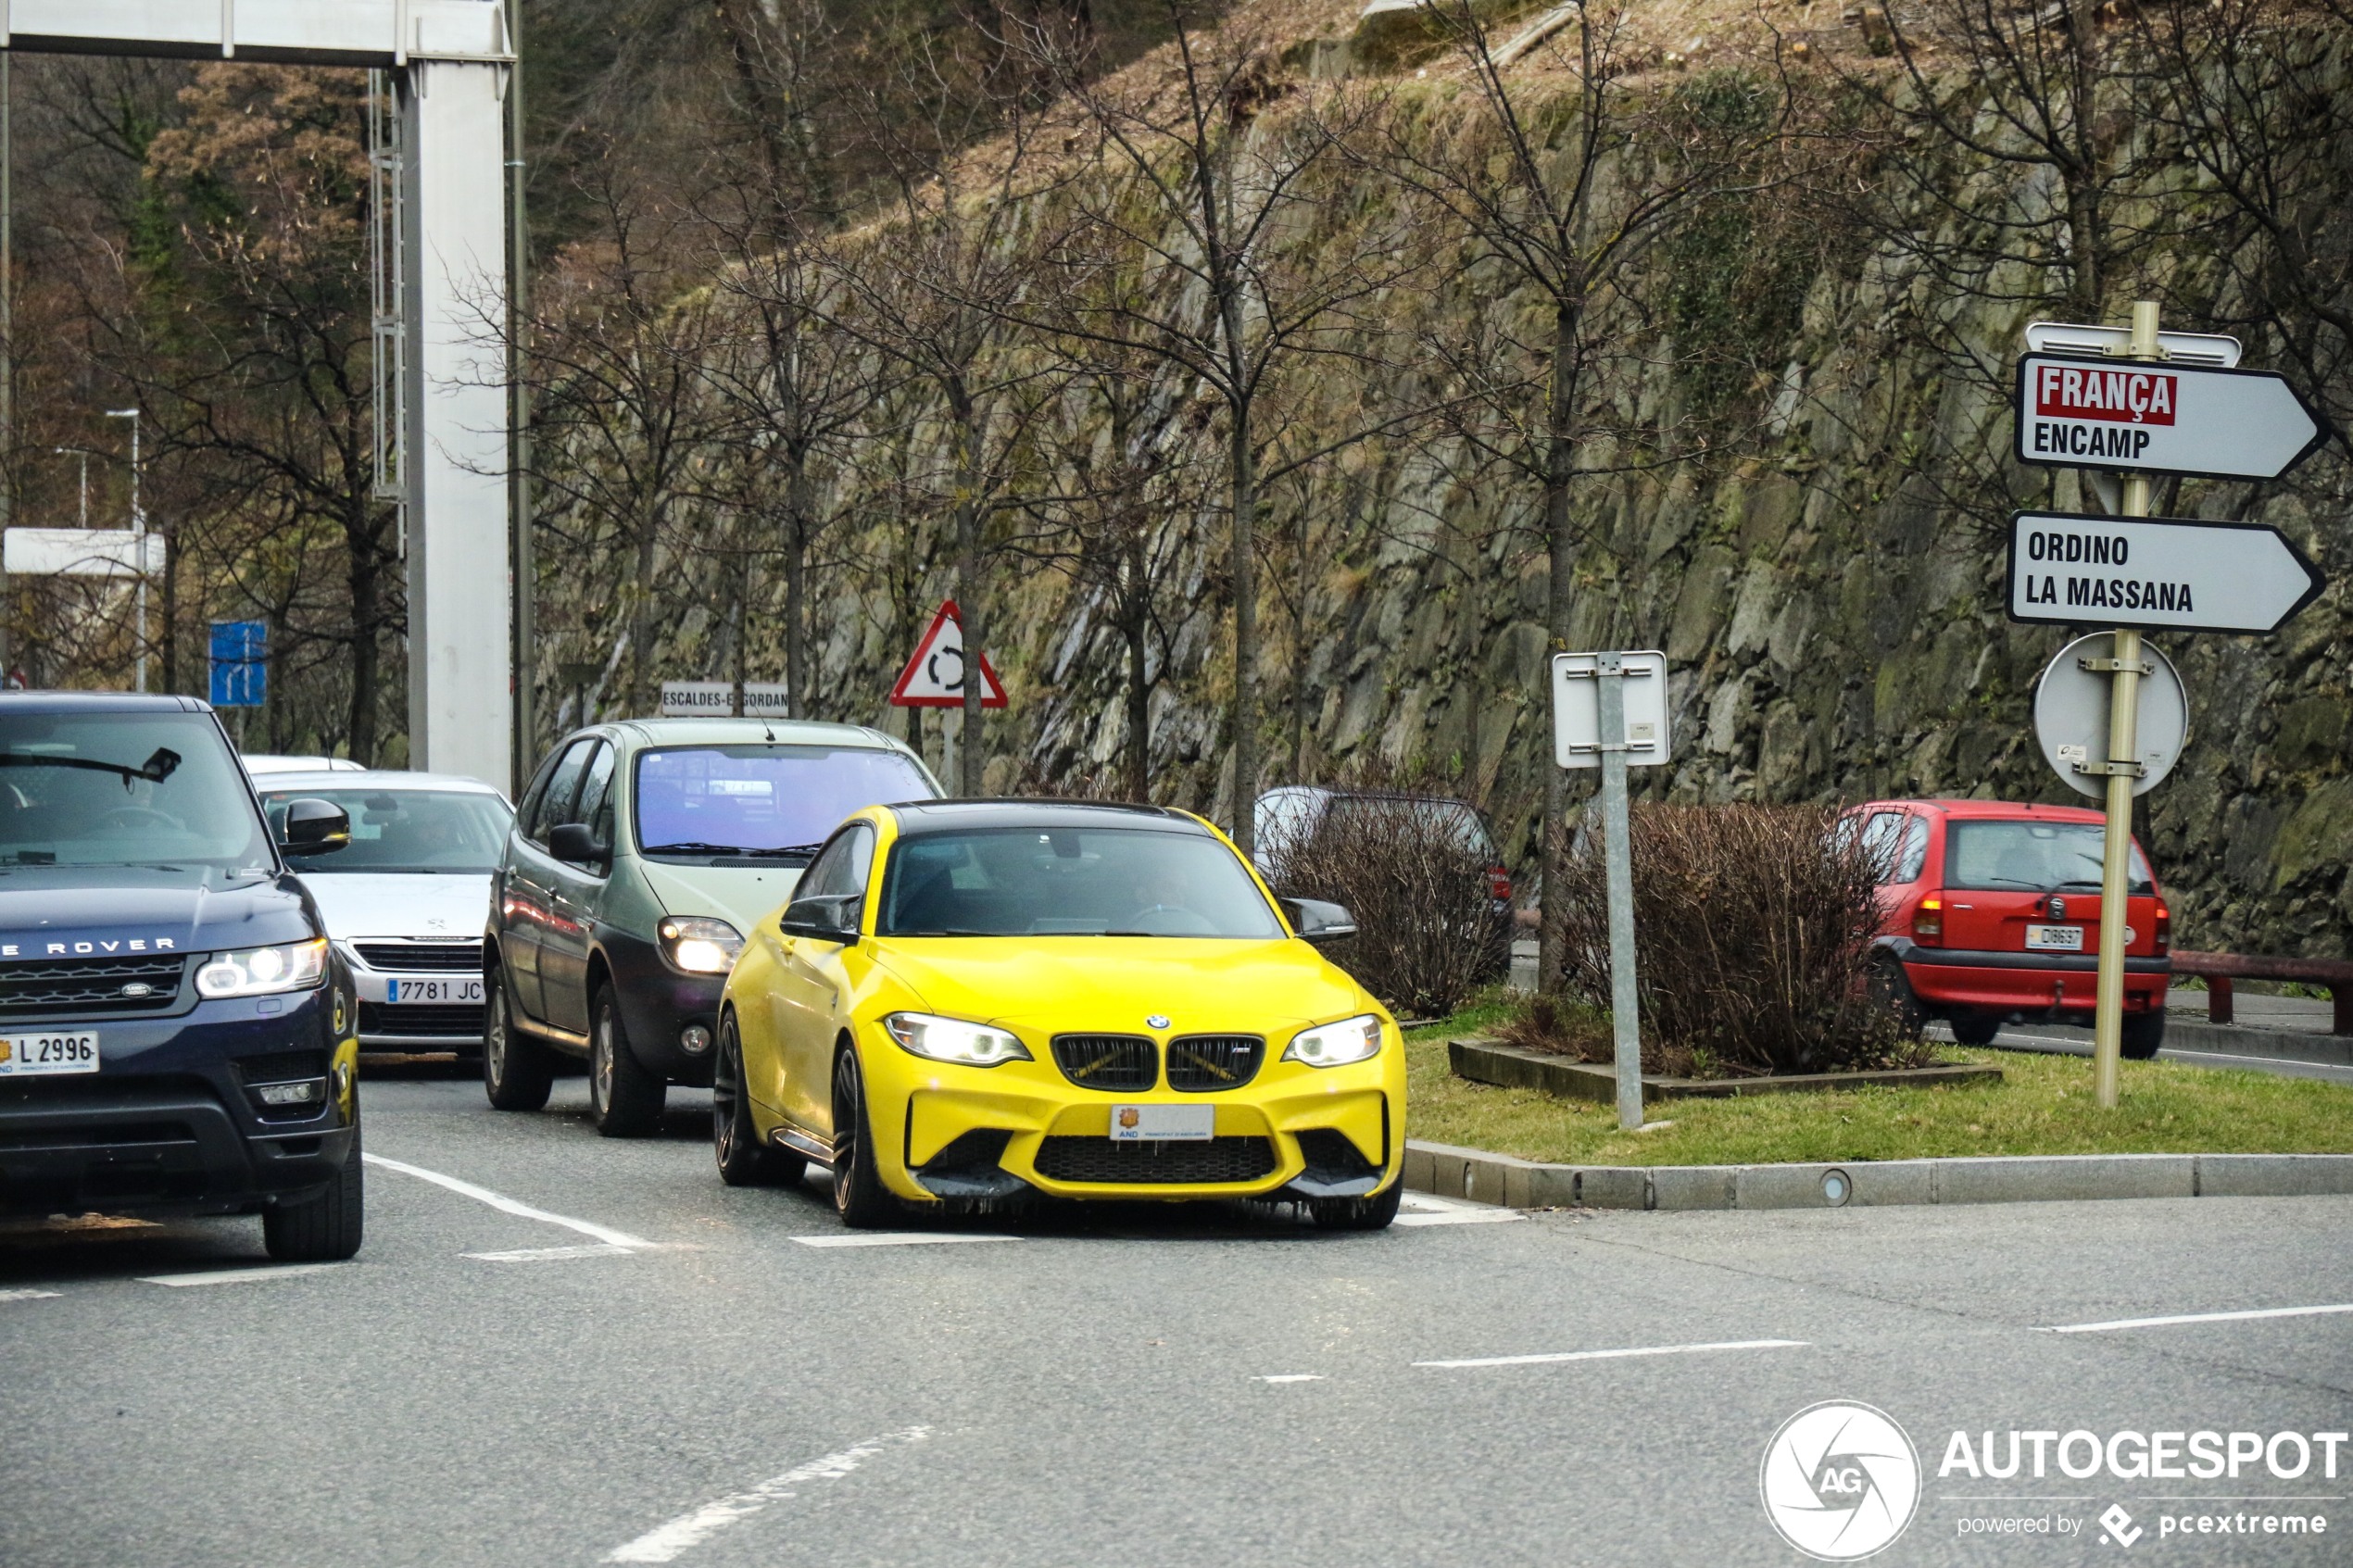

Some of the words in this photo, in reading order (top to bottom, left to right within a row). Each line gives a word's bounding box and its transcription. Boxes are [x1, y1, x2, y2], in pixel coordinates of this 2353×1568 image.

[2042, 368, 2171, 422] FRANÇA
[2034, 422, 2150, 459] ENCAMP
[2029, 532, 2129, 566] ORDINO
[2026, 575, 2057, 605] LA
[2067, 577, 2194, 612] MASSANA
[663, 692, 788, 708] ESCALDES-EGORDAN
[46, 938, 175, 954] ROVER
[401, 982, 447, 999] 7781
[20, 1039, 31, 1063] L
[39, 1037, 92, 1062] 2996
